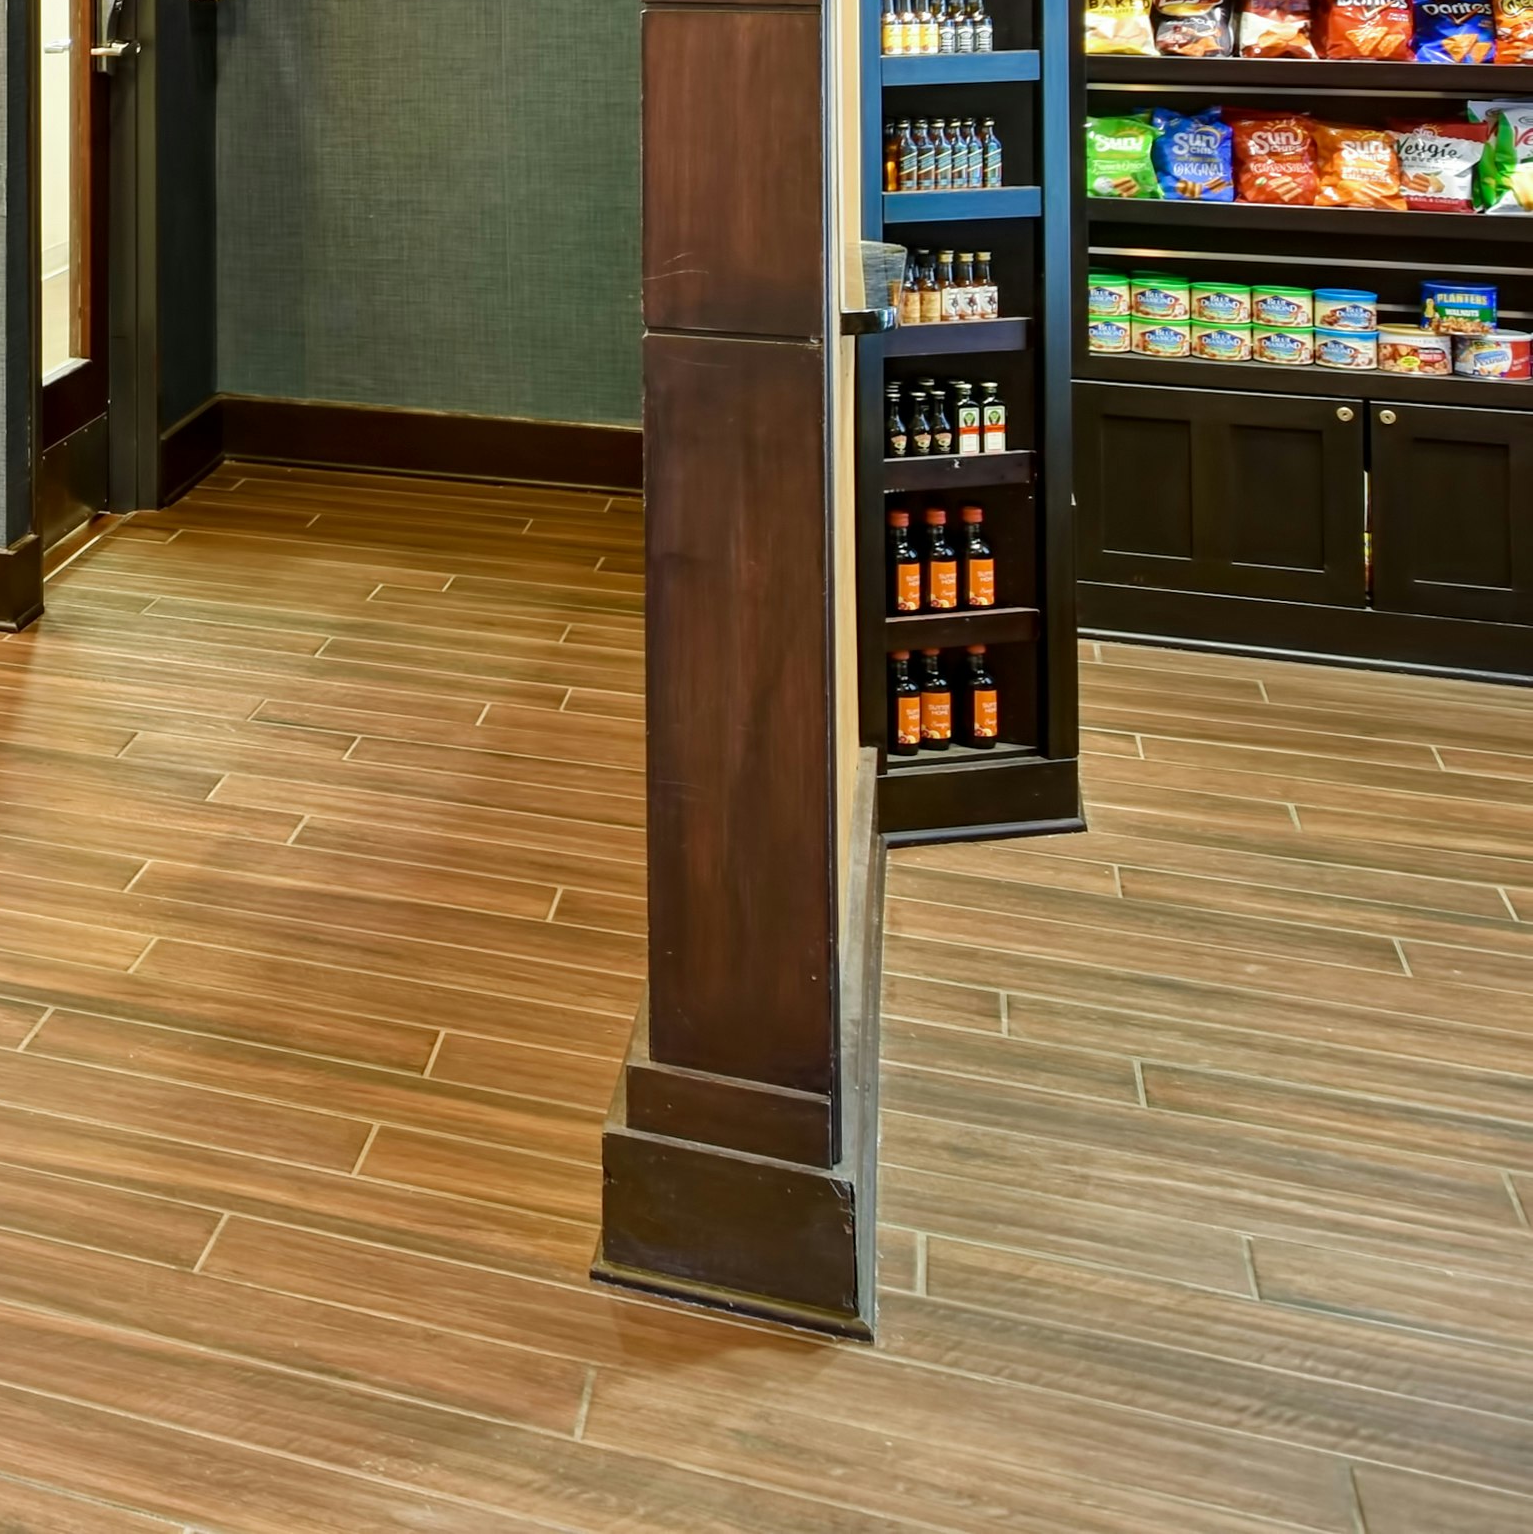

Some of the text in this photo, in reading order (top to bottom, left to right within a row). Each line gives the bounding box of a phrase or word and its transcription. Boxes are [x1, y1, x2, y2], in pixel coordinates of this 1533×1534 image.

[1422, 2, 1492, 16] Doritos
[1173, 132, 1217, 154] Sun
[1252, 131, 1303, 155] Sun
[1396, 137, 1462, 158] Veggie
[1174, 162, 1228, 177] ORIGINAL
[1137, 294, 1175, 304] DIAMOND
[1201, 300, 1239, 309] DIAMOND
[1437, 293, 1488, 306] PLANTERS
[1258, 303, 1297, 312] DIAMOND
[1146, 333, 1182, 342] DIAMOND
[1202, 337, 1241, 346] DIAMOND
[1262, 340, 1301, 349] DIAMOND
